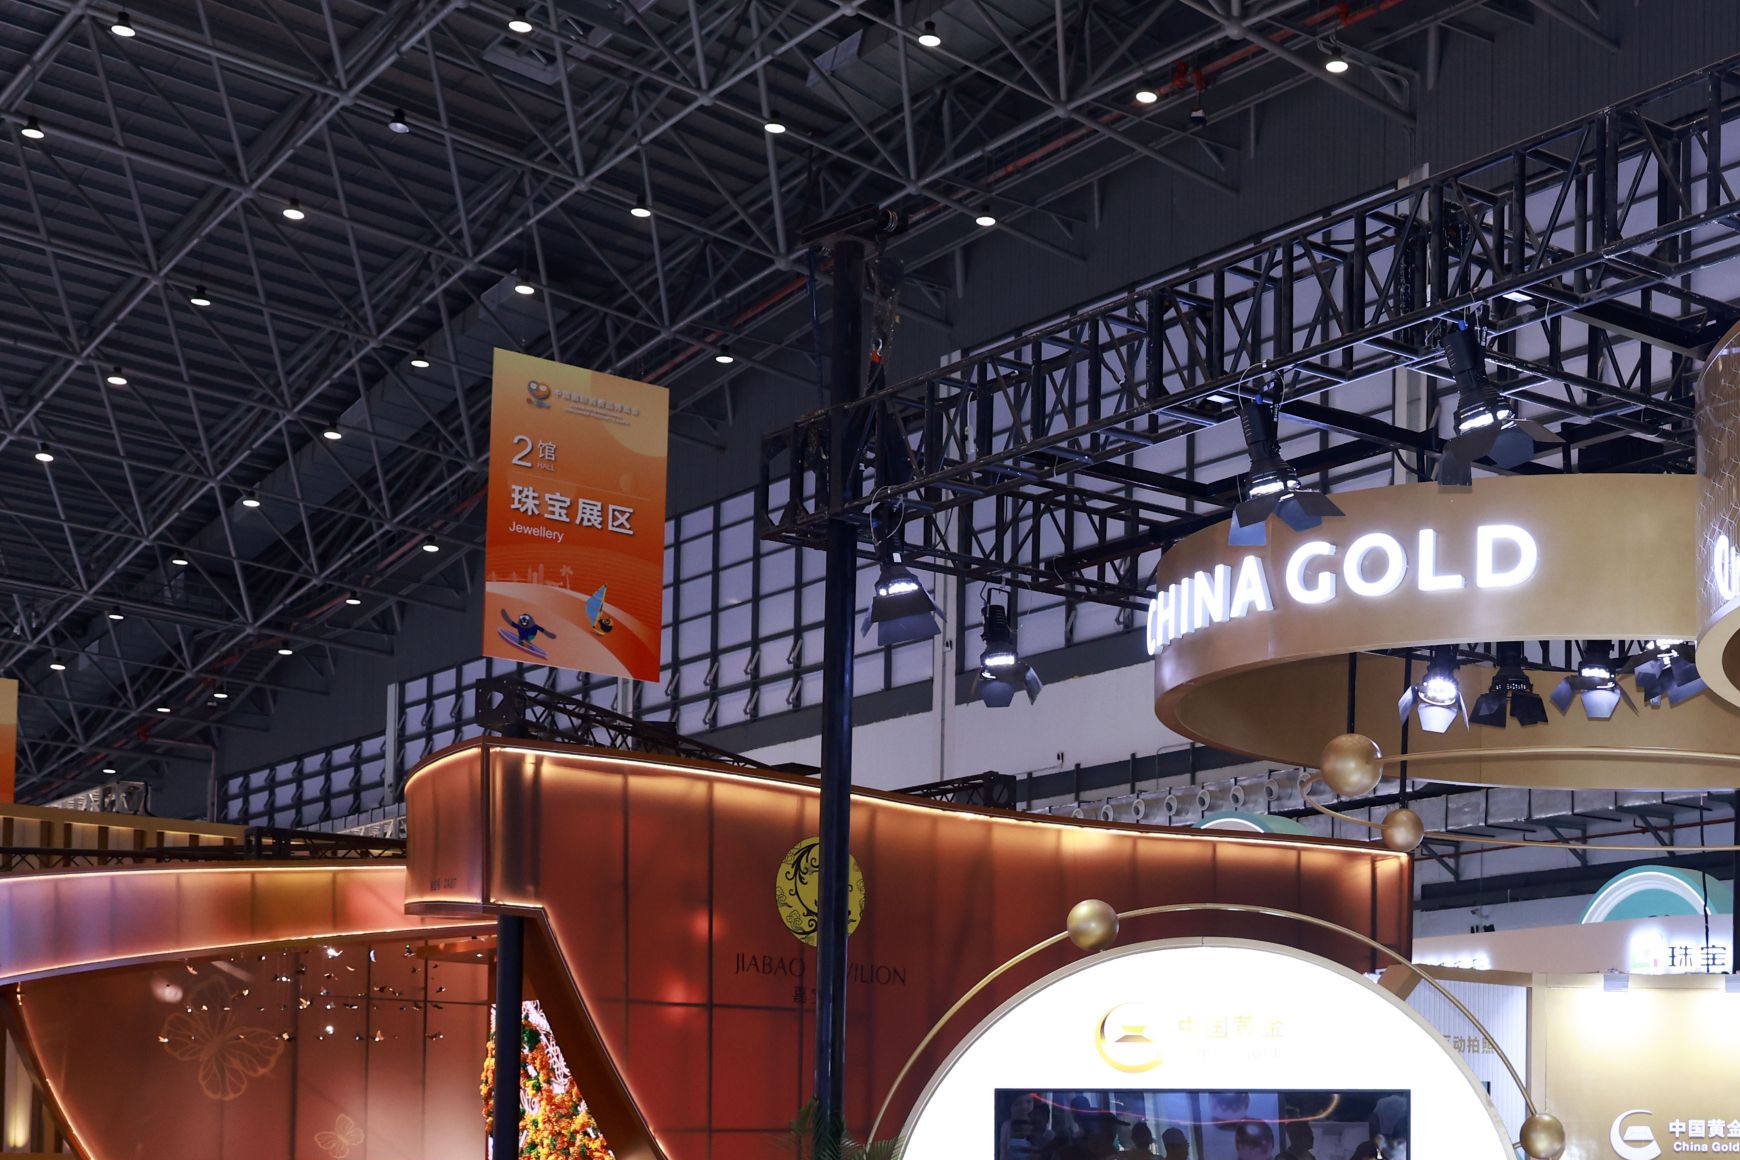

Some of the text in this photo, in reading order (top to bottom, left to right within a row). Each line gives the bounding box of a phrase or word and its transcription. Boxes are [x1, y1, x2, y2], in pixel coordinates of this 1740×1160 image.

[537, 462, 555, 472] HALL
[510, 484, 635, 536] 珠宝展区
[508, 521, 565, 544] Jewellery
[1147, 524, 1538, 656] CHINA GOLD
[735, 952, 806, 977] JIABAO
[1673, 1141, 1740, 1152] China Gold
